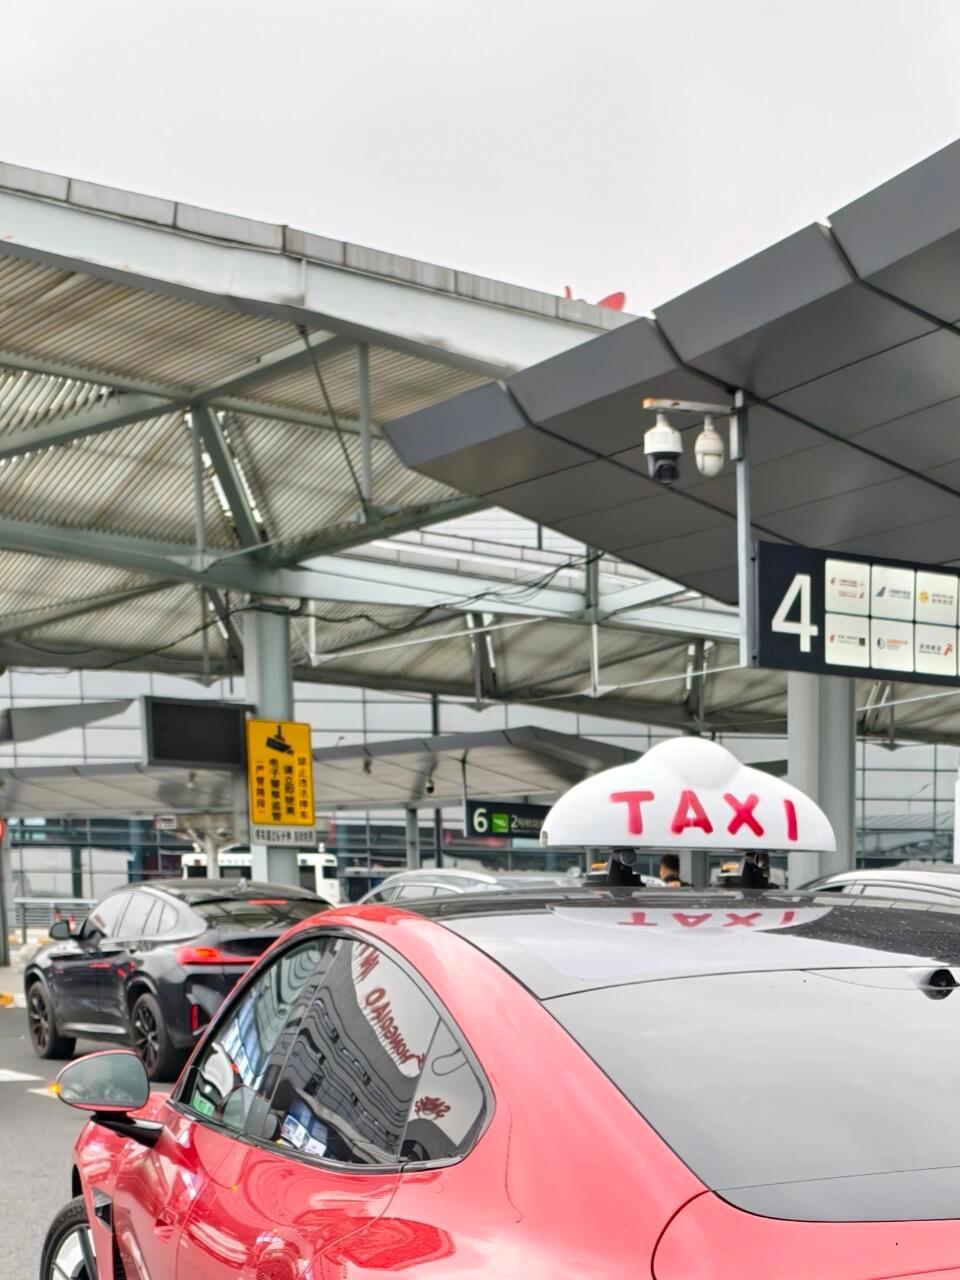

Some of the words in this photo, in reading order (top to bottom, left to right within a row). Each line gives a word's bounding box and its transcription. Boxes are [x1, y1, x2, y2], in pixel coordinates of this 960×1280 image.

[770, 573, 819, 653] 4
[473, 807, 488, 833] 6
[610, 790, 799, 842] TAXI
